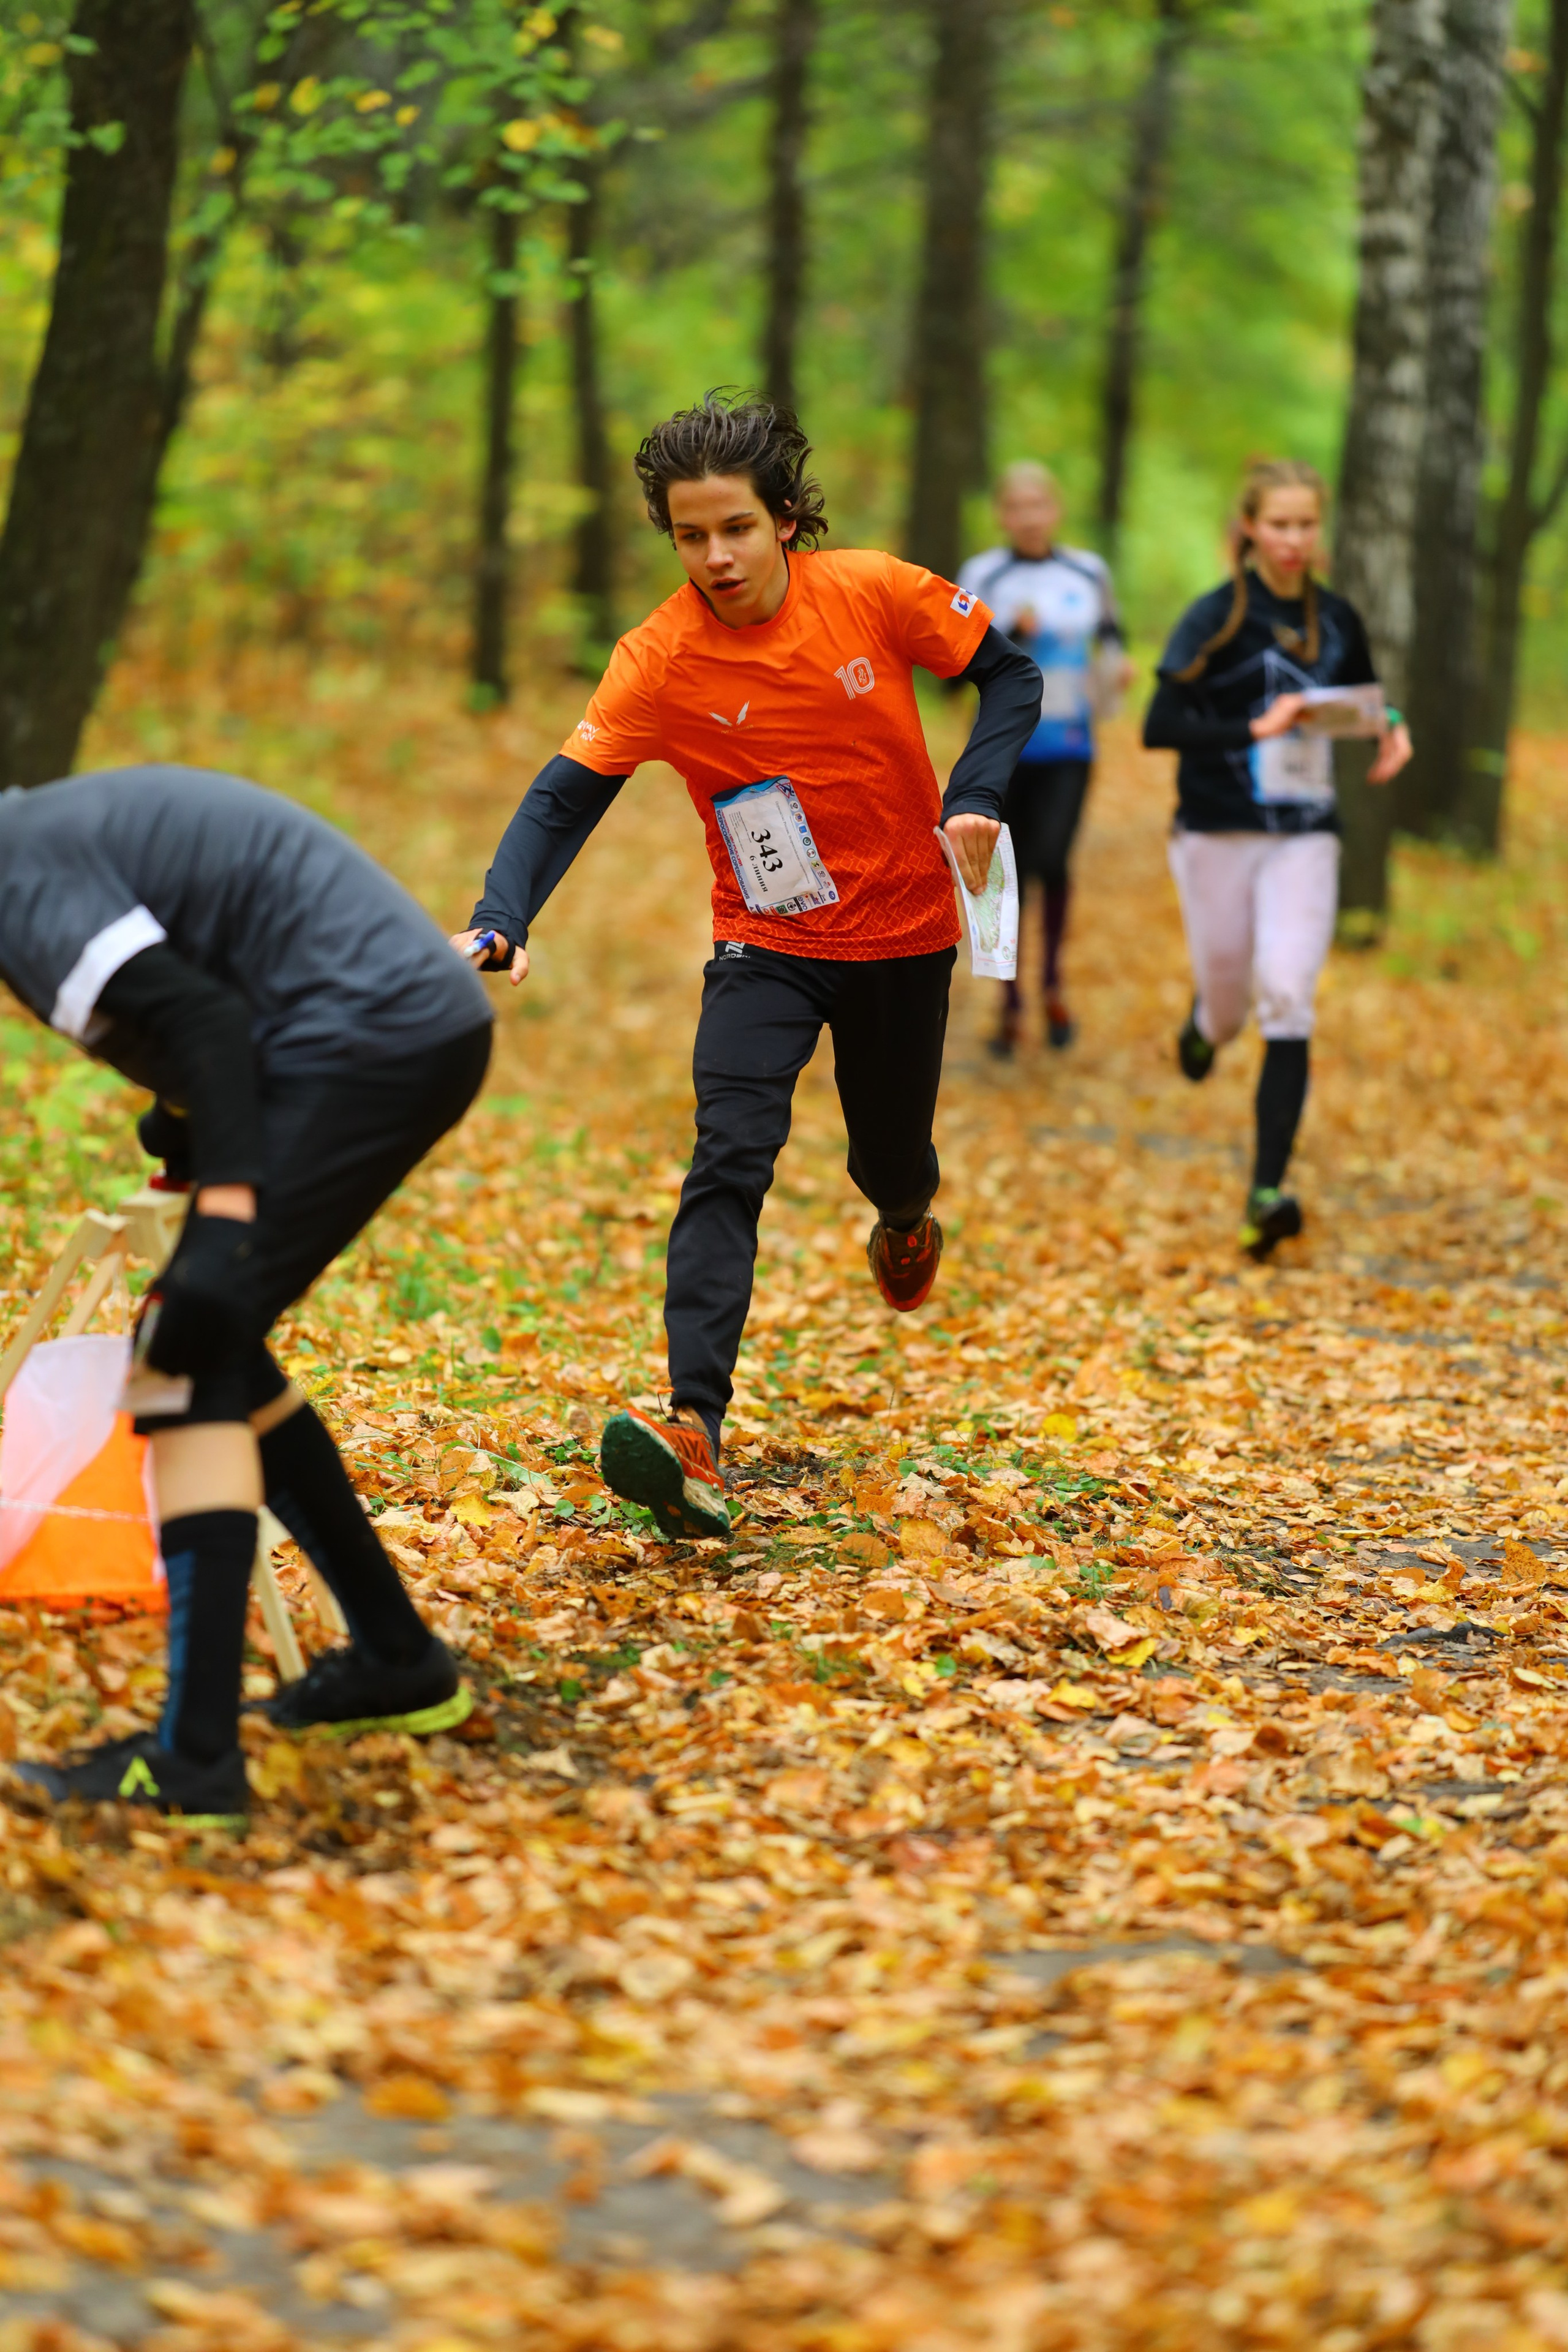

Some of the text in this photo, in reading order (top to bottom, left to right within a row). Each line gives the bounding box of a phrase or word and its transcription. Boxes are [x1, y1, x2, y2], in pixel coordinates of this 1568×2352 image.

[834, 657, 875, 700] 10
[717, 810, 734, 855] ВСЕРОССИЙСКИЕ
[731, 856, 750, 900] СОРЕВНОВАНИЯ
[752, 828, 783, 872] 343
[752, 863, 768, 892] линия
[797, 896, 808, 911] evo
